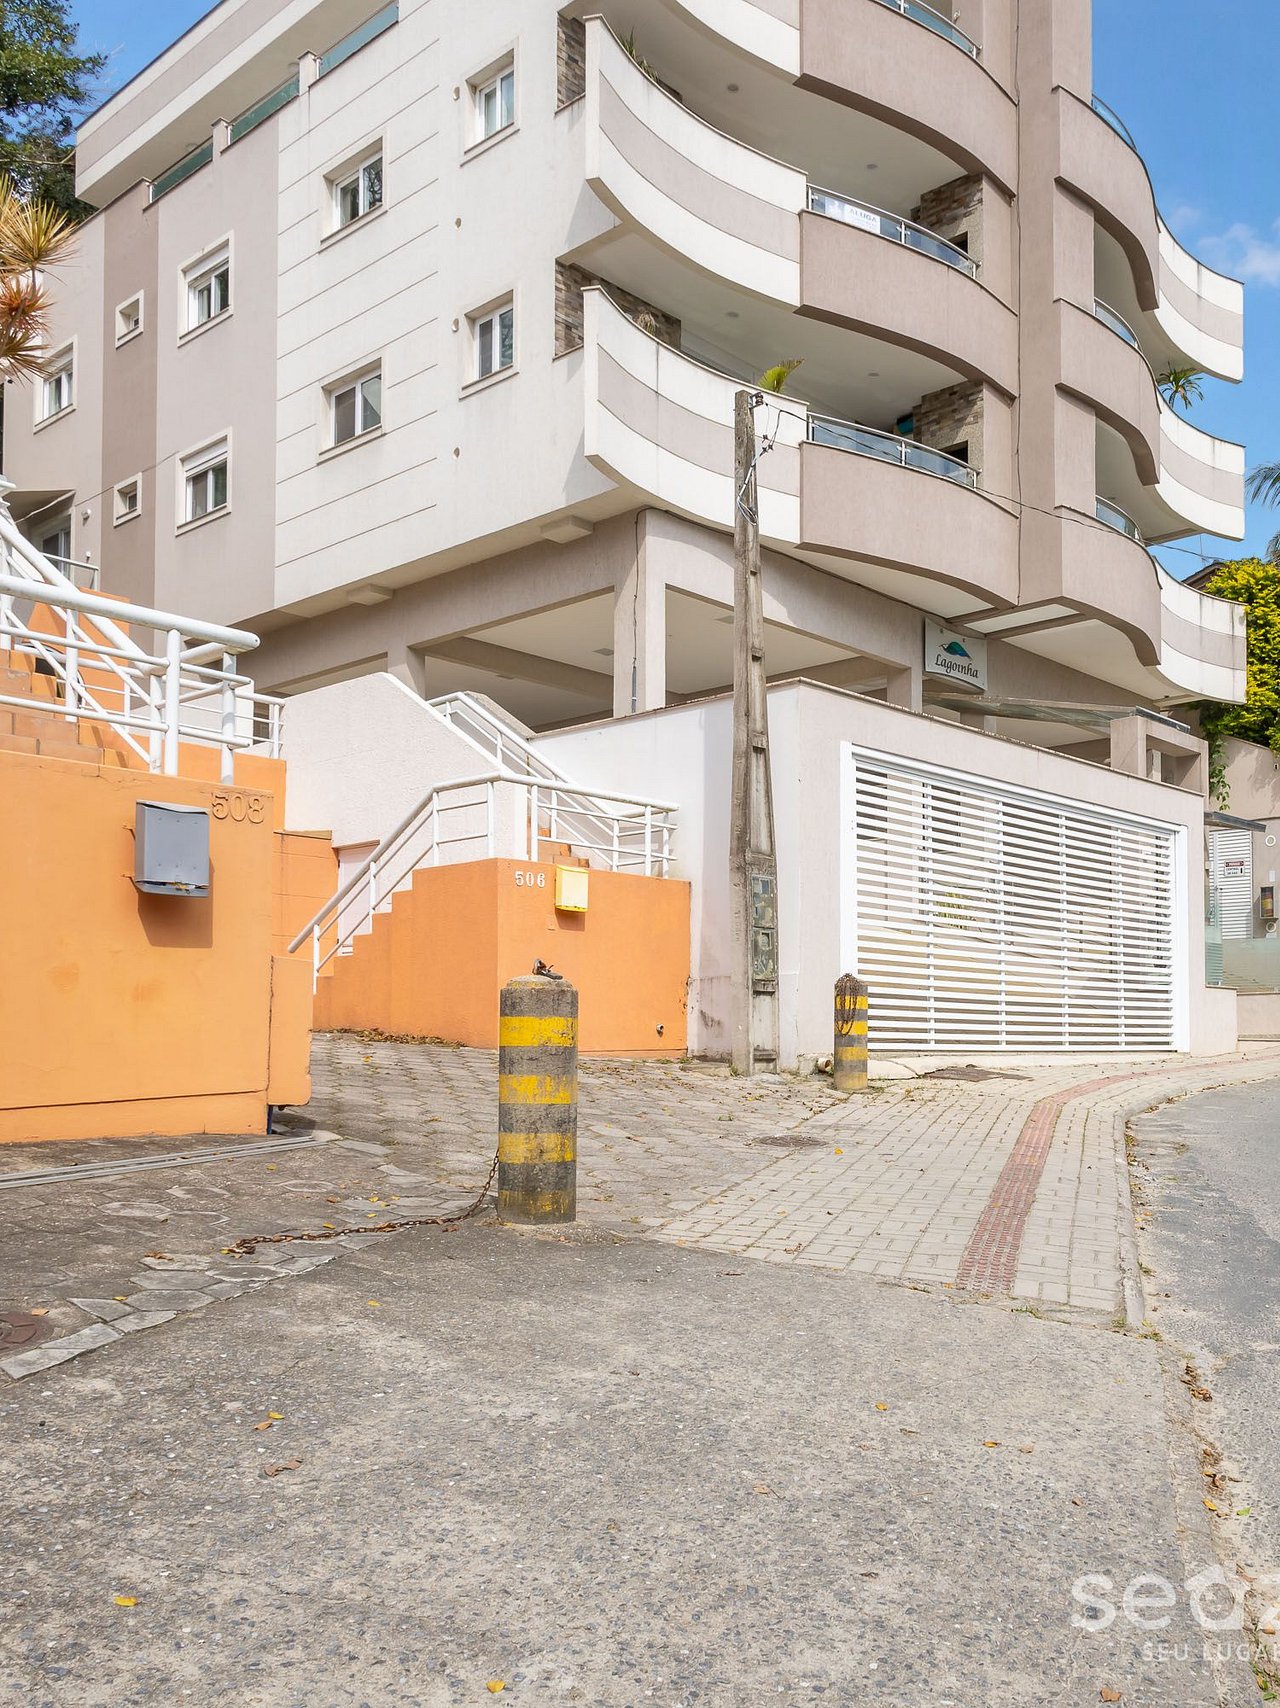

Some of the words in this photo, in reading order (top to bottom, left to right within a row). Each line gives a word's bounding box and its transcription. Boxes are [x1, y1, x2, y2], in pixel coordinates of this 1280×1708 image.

[935, 654, 978, 679] Lagoinha
[211, 793, 265, 825] 508
[515, 871, 546, 888] 506
